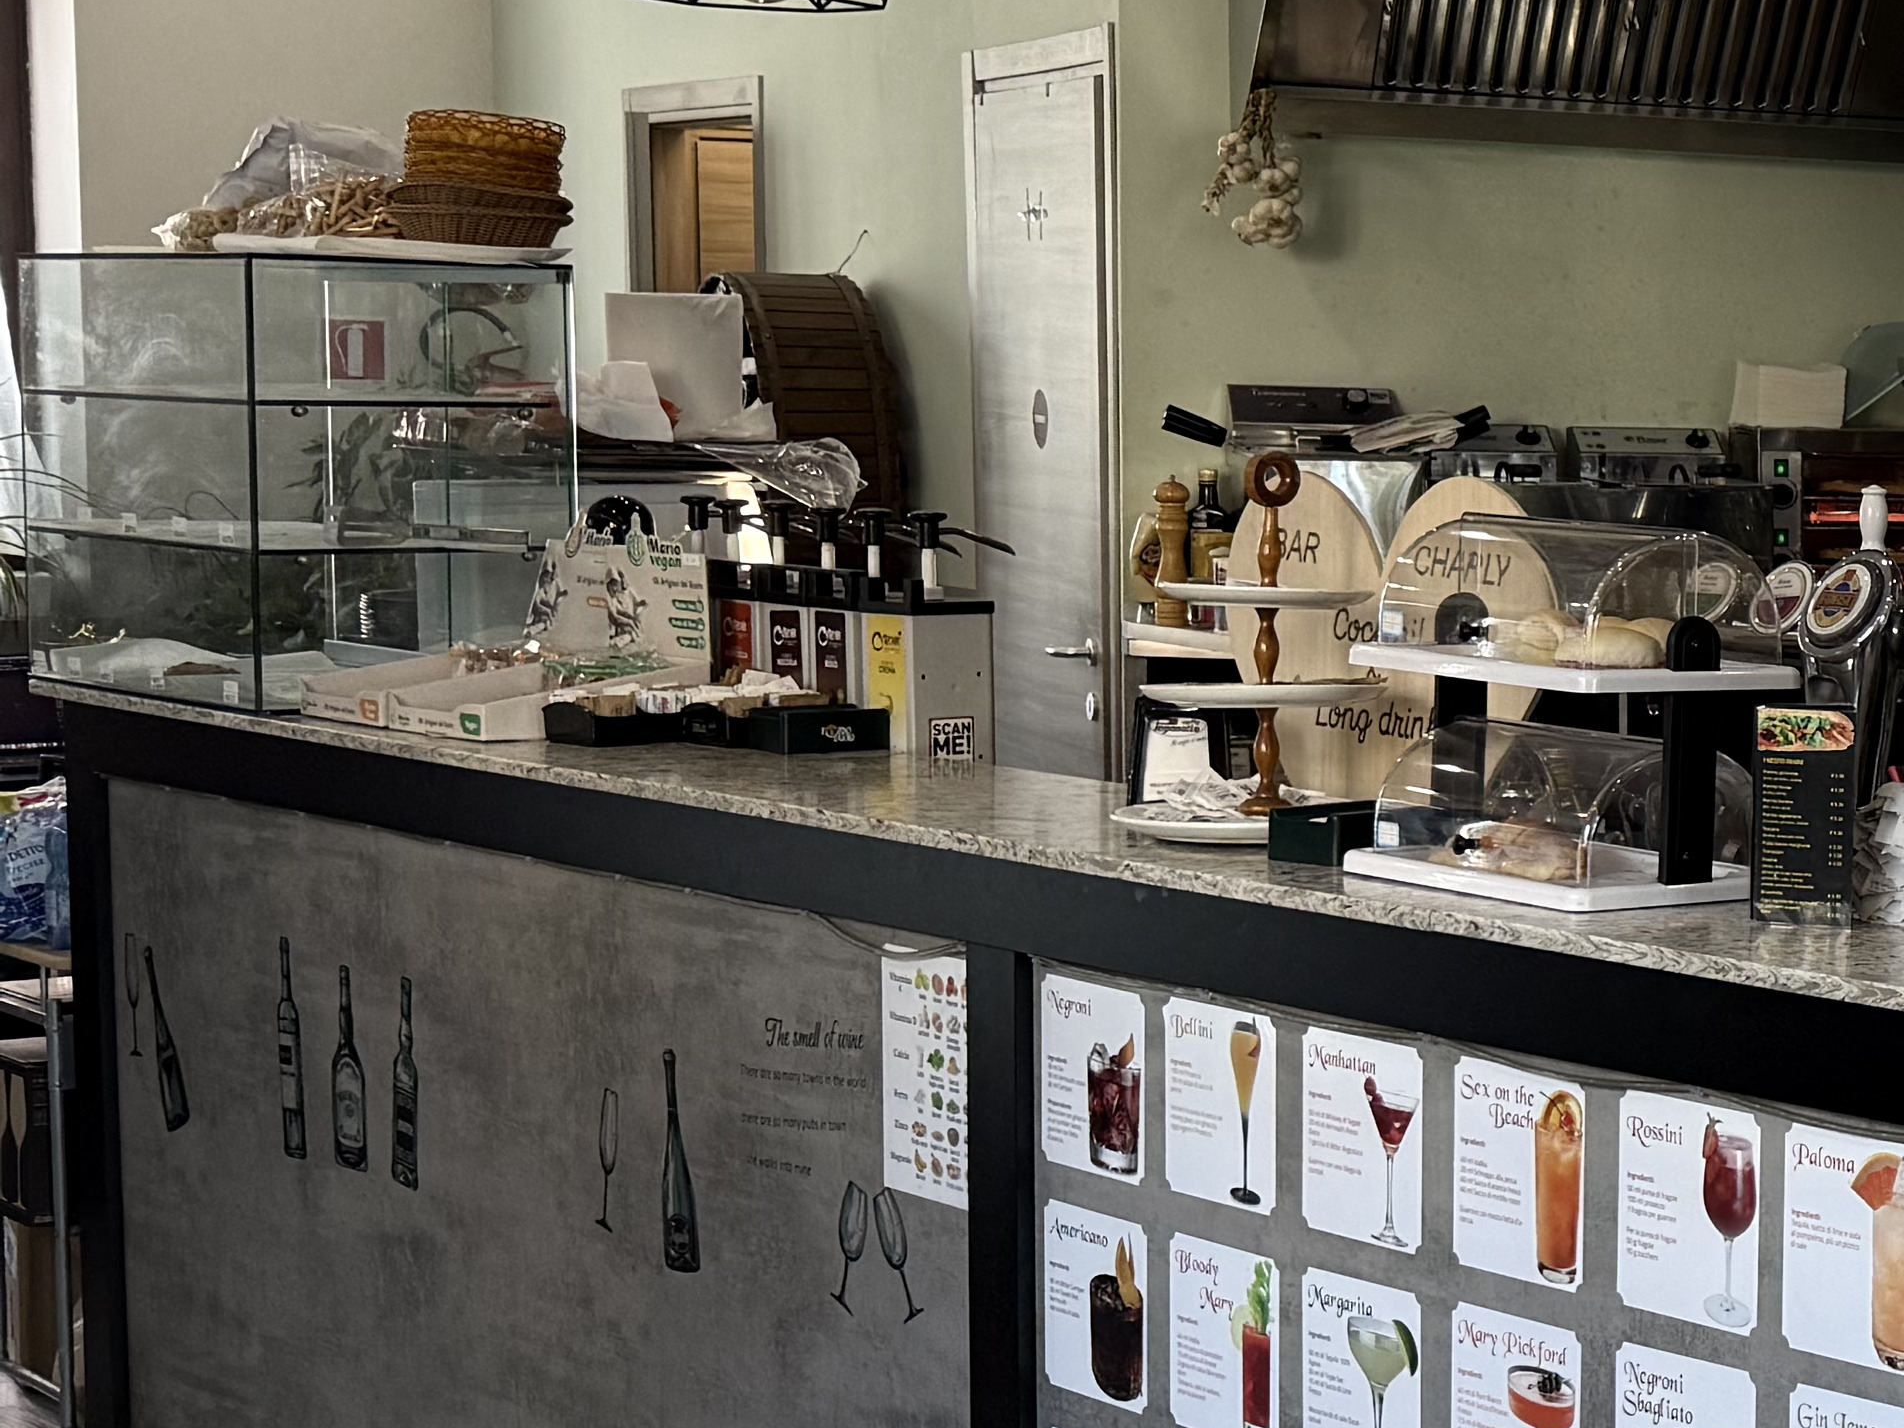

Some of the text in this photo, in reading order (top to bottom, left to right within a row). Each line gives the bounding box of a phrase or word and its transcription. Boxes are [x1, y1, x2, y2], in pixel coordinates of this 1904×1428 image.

[1279, 529, 1320, 564] BAR
[1415, 546, 1511, 587] CHARLY
[932, 721, 971, 737] SCAN
[934, 737, 972, 756] ME!
[1046, 988, 1092, 1017] Negroni
[765, 1017, 864, 1049] The smell of wine
[1170, 1014, 1214, 1042] Bellini
[1307, 1042, 1377, 1075] Manhattan
[1461, 1073, 1535, 1109] Sex on the
[1489, 1104, 1536, 1131] Beach
[1626, 1114, 1684, 1147] Rossini
[1792, 1142, 1856, 1175] Paloma
[1049, 1216, 1108, 1248] Americano
[1174, 1248, 1219, 1284] Bloody
[1199, 1286, 1234, 1315] Mary
[1307, 1284, 1373, 1318] Margarita
[1459, 1318, 1567, 1367] Mary Pickford
[1624, 1361, 1684, 1395] Negroni
[1622, 1390, 1693, 1425] Sbagliato
